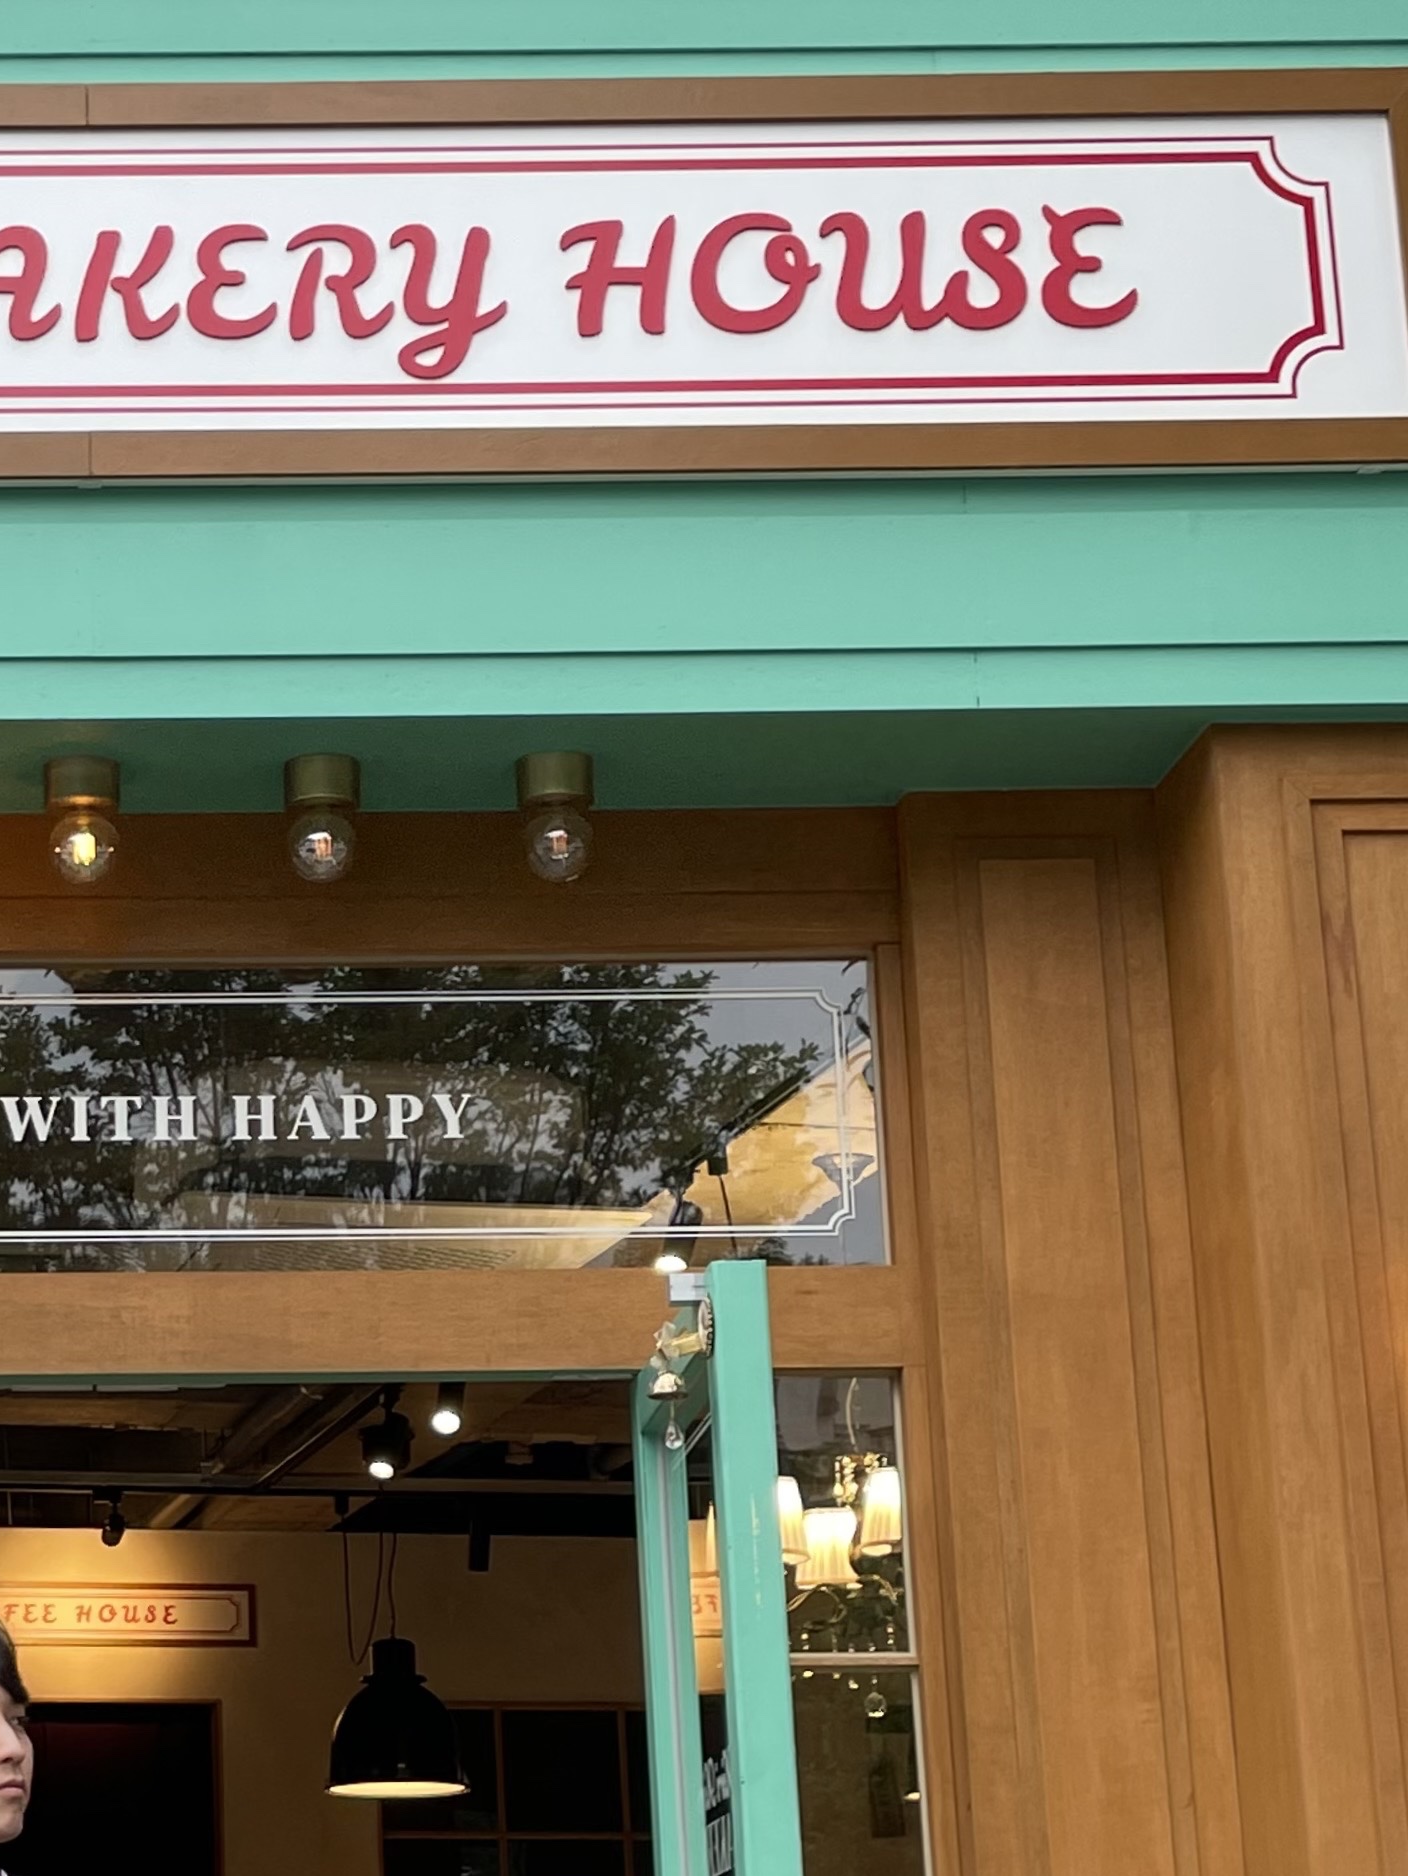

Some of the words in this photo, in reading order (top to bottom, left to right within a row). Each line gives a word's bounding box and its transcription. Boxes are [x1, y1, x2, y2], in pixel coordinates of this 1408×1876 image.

[559, 206, 1139, 339] HOUSE
[230, 1093, 473, 1142] HAPPY
[74, 1602, 180, 1626] HOUSE
